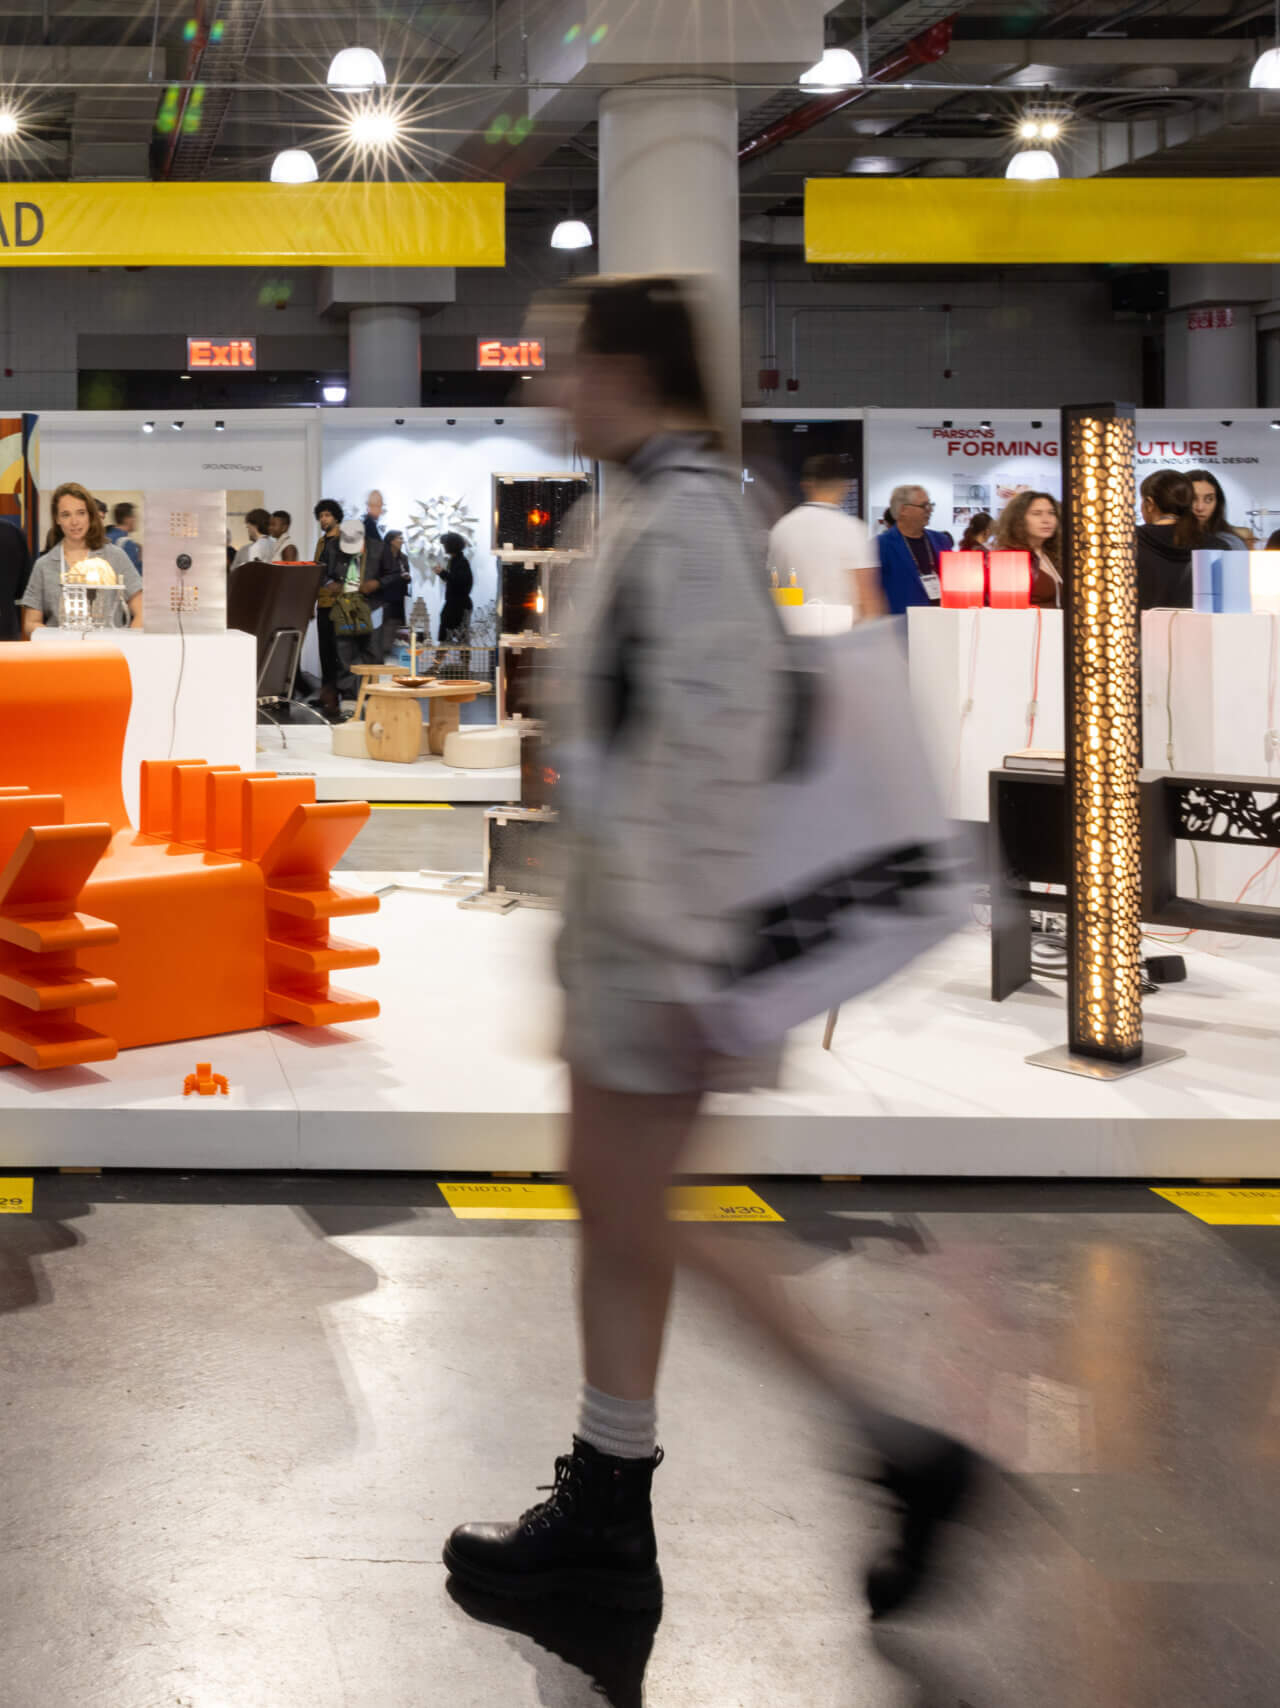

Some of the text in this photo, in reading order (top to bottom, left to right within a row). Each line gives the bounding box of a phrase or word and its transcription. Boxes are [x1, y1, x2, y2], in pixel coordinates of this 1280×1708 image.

[190, 341, 255, 367] Exit
[479, 341, 544, 367] Exit
[932, 428, 995, 439] PARSONS
[947, 441, 1219, 457] FORMING UTURE
[1222, 457, 1260, 465] DESIGN
[445, 1184, 513, 1193] STUDIO
[719, 1206, 766, 1215] W30
